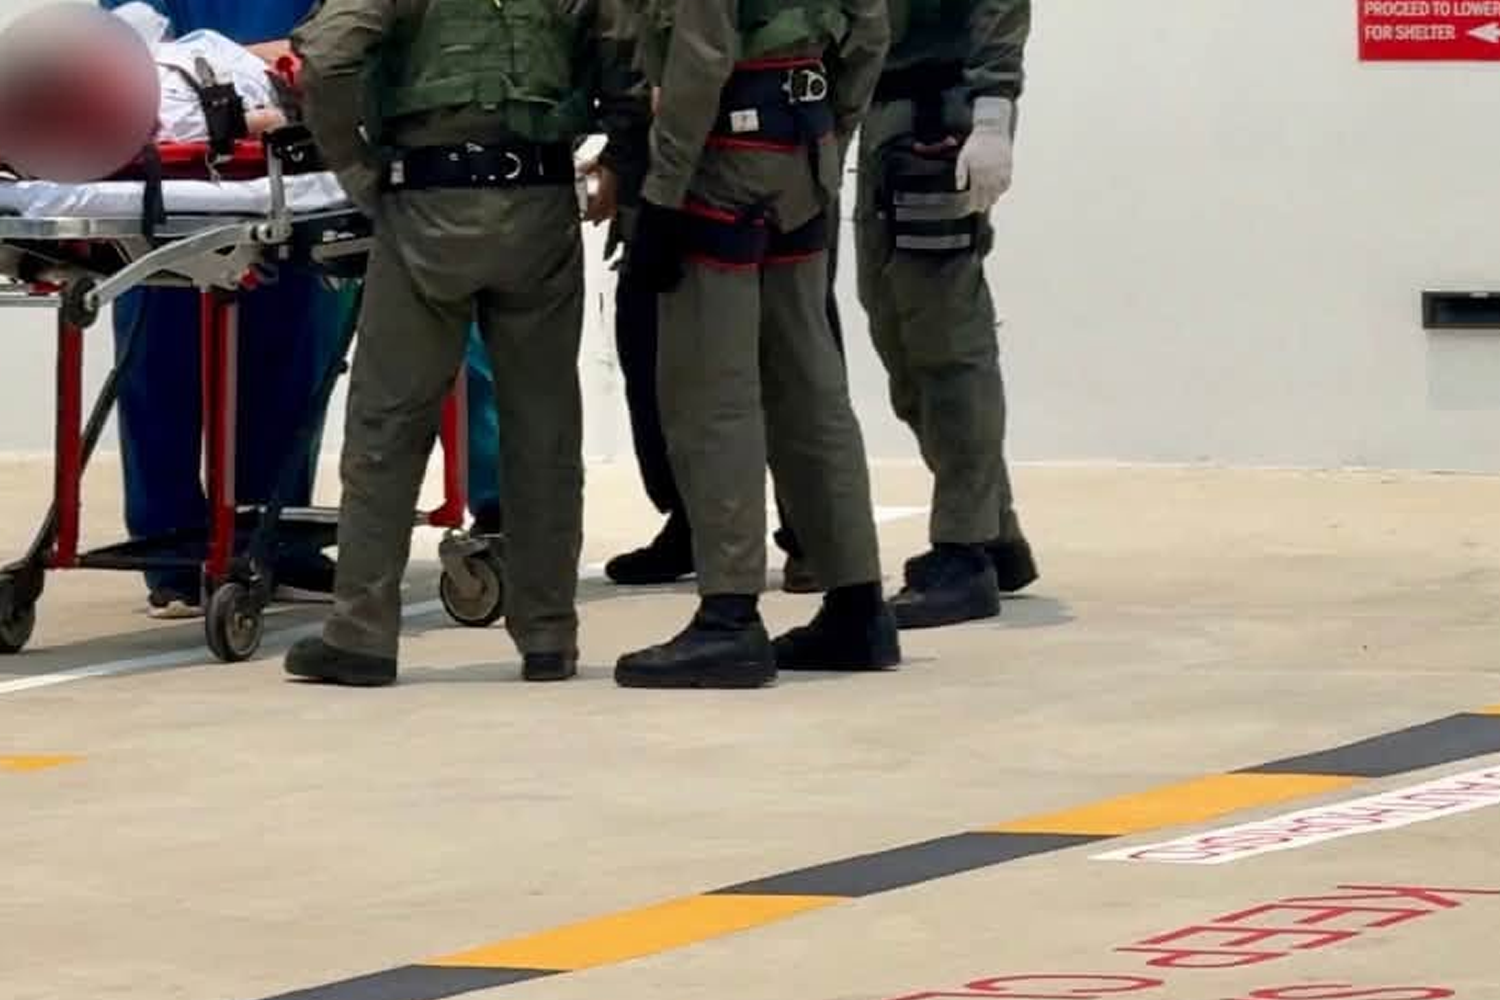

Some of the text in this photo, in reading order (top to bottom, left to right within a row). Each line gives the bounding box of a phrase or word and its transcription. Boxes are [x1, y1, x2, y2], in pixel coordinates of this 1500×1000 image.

[1365, 1, 1429, 16] PROCEED
[1432, 1, 1450, 16] TO
[1365, 25, 1455, 40] FOR SHELTER
